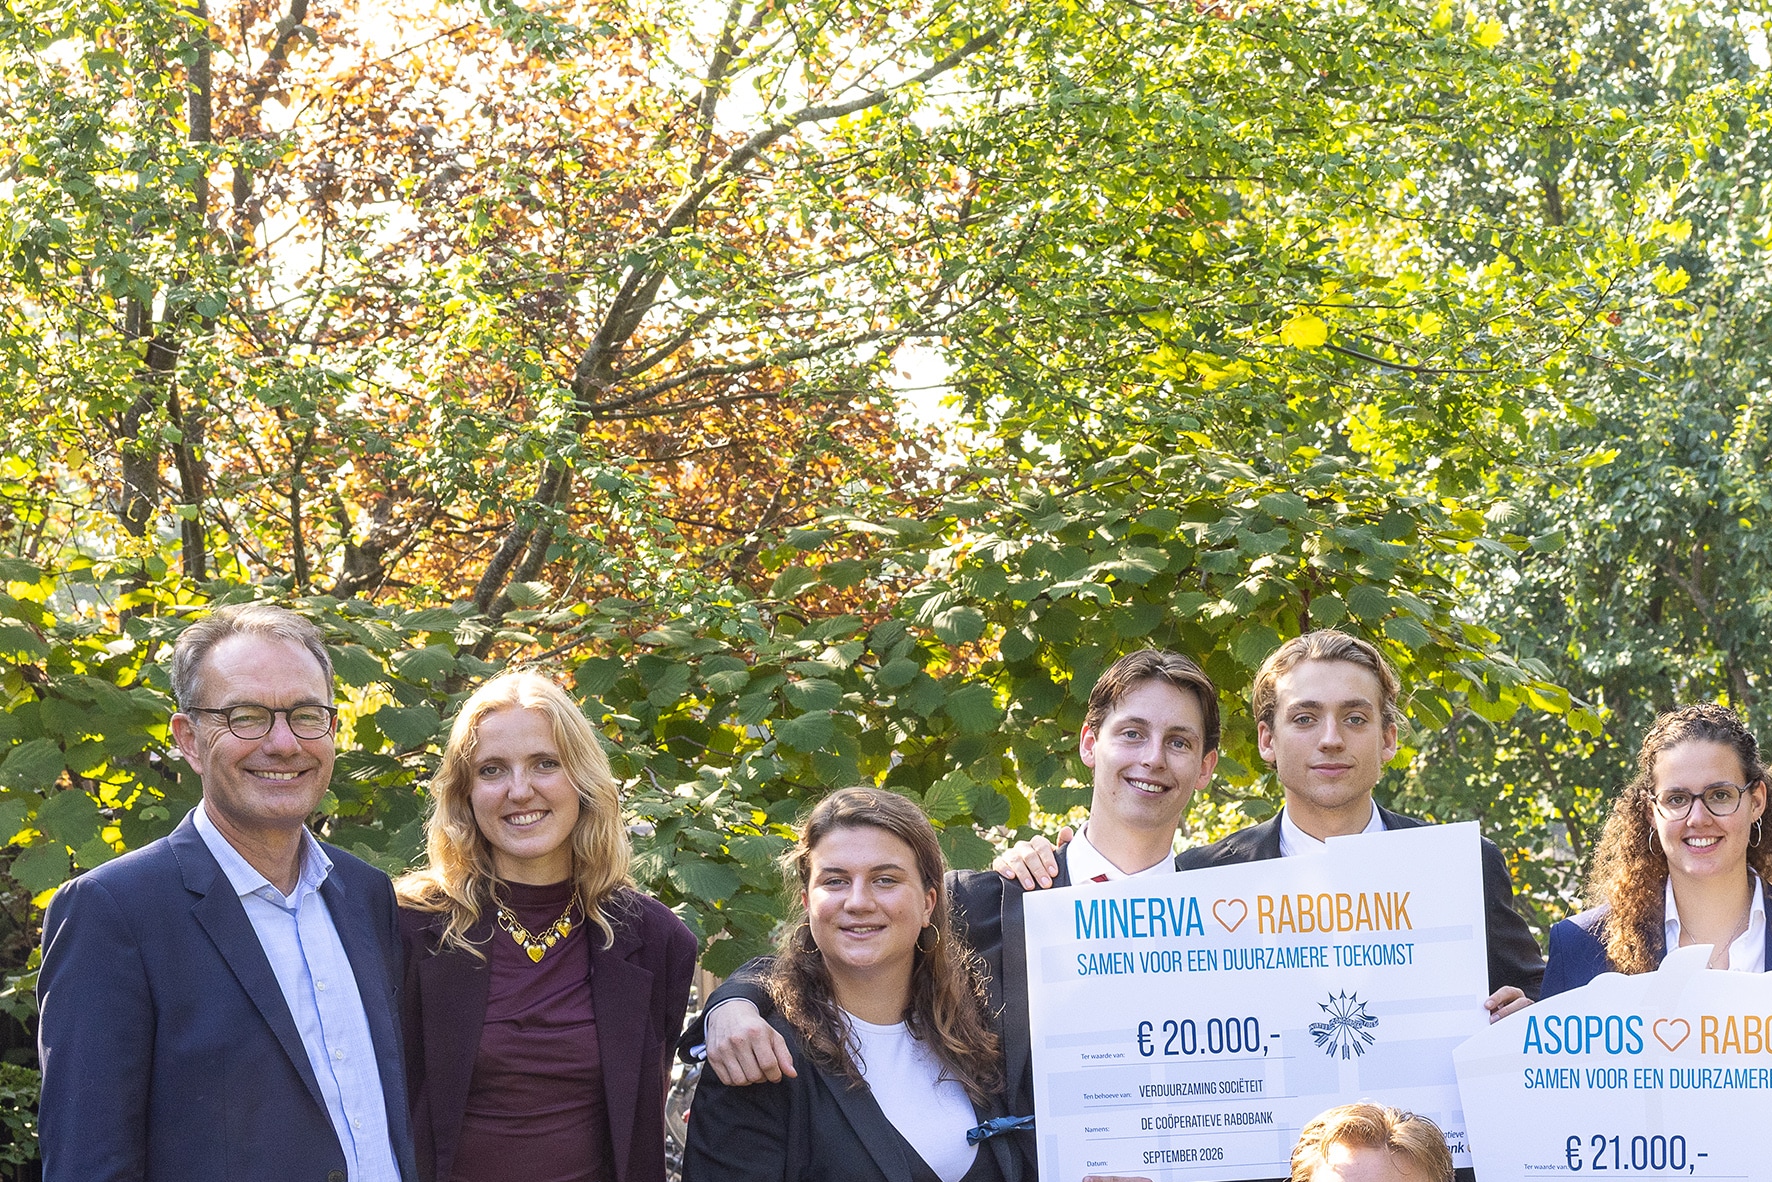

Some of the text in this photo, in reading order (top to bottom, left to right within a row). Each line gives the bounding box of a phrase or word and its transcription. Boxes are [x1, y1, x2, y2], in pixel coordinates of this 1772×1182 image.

[1074, 891, 1413, 940] MINERVA RABOBANK
[1077, 943, 1414, 976] SAMEN VOOR EEN DUURZAMERE TOEKOMST
[1137, 1017, 1280, 1057] € 20.000,-
[1523, 1015, 1644, 1055] ASOPOS
[1091, 1052, 1112, 1060] waarde
[1139, 1077, 1264, 1098] VERDUURZAMING SOCIËTEIT
[1524, 1068, 1580, 1090] SAMEN
[1585, 1068, 1628, 1089] VOOR
[1634, 1068, 1664, 1089] EEN
[1093, 1092, 1119, 1100] behoeve
[1084, 1125, 1110, 1133] Namens:
[1141, 1111, 1274, 1131] DE COÖPERATIEVE RABOBANK
[1143, 1147, 1224, 1165] SEPTEMBER 2026
[1565, 1134, 1708, 1175] € 21.000,-
